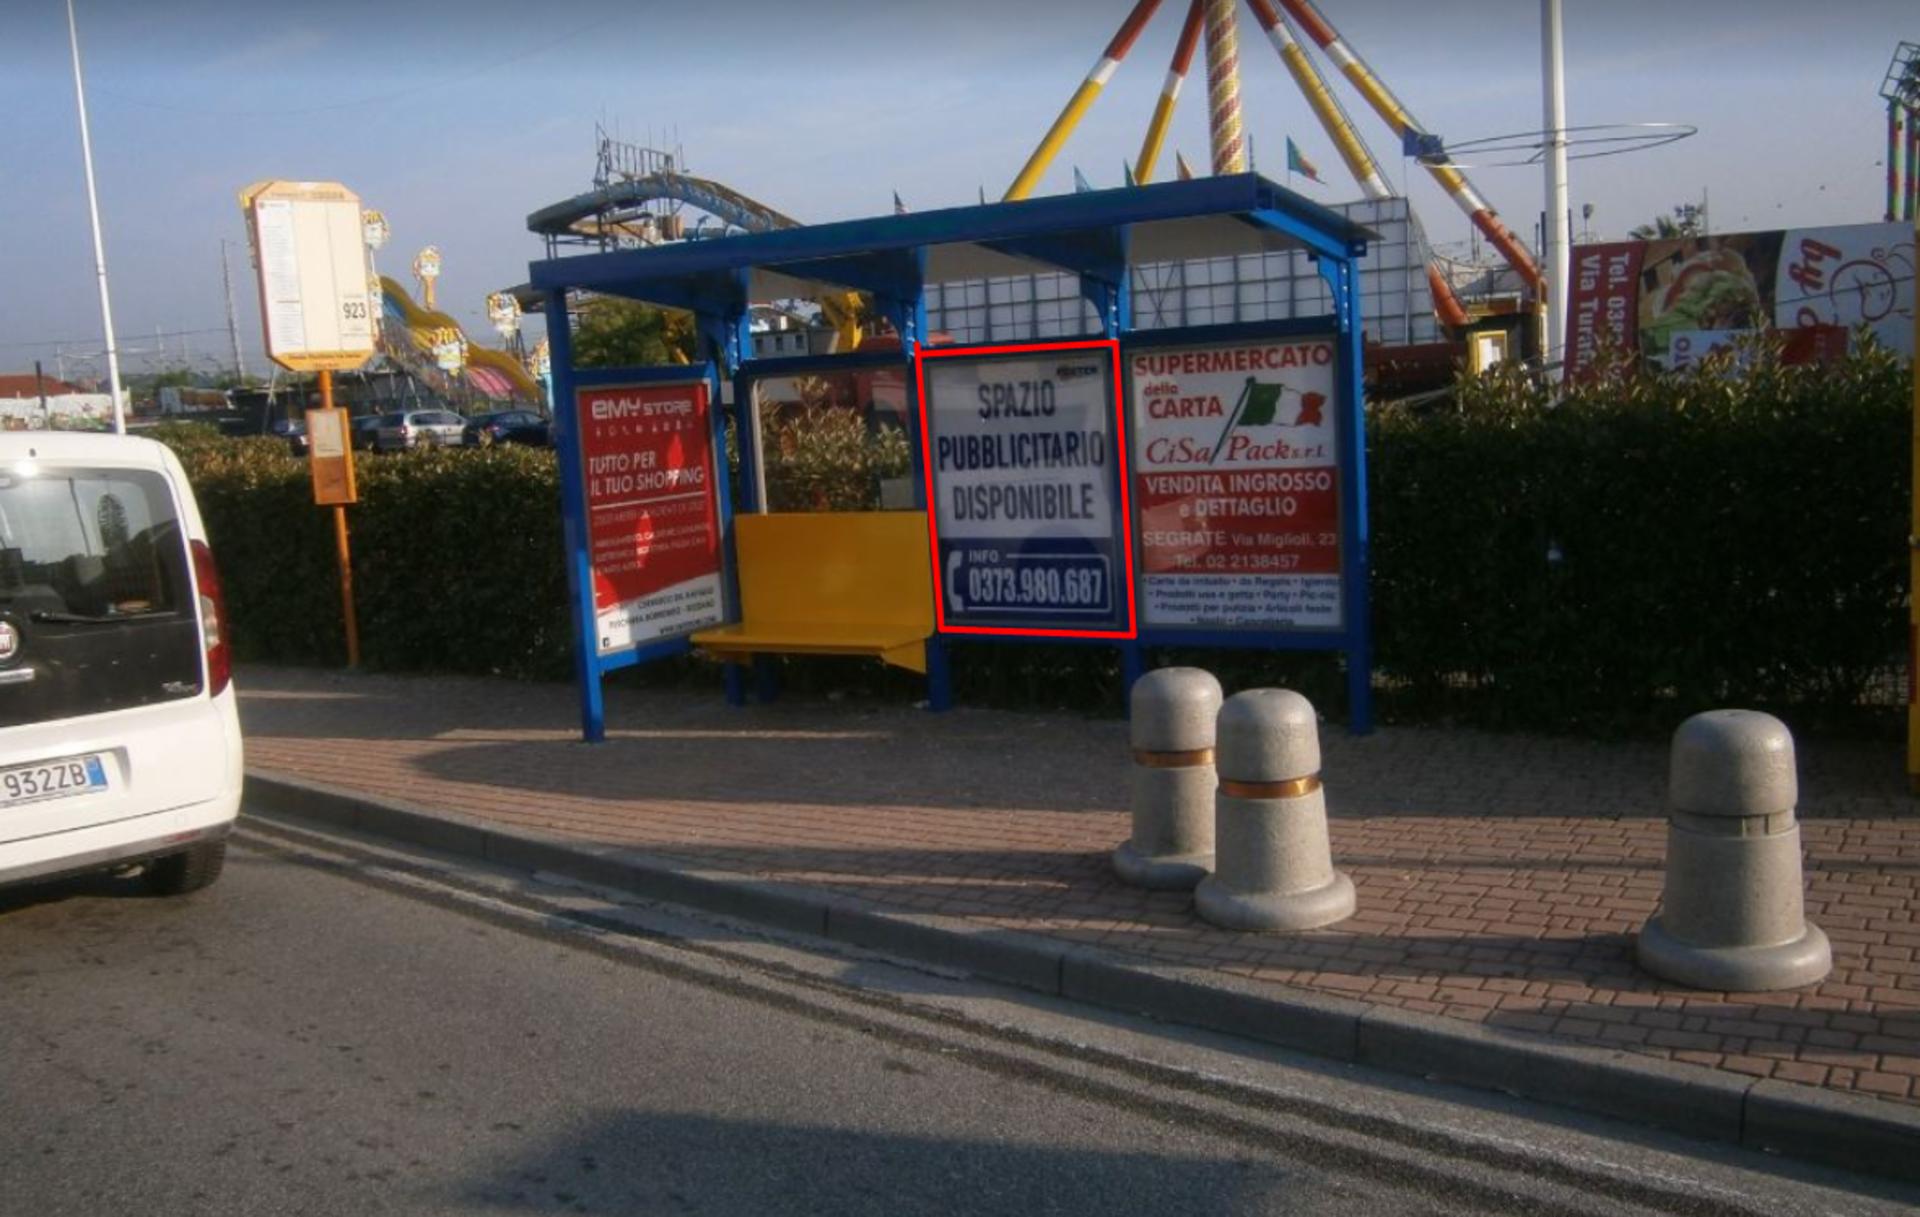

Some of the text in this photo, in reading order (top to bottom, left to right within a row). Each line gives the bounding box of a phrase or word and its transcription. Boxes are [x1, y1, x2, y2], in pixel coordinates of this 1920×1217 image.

[1581, 254, 1601, 291] Via
[1609, 252, 1630, 291] Tel.
[342, 302, 366, 319] 923
[1135, 344, 1332, 376] SUPERMERCATO
[977, 379, 1056, 420] SPAZIO
[1143, 382, 1178, 396] della
[643, 400, 693, 416] STORE
[1149, 395, 1224, 419] CARTA
[589, 450, 657, 475] TUTTO PER
[937, 431, 1105, 472] PUBBLICITARIO
[1146, 435, 1211, 465] CiSa
[1225, 435, 1291, 462] Pack
[591, 466, 705, 496] IL TUO SHOPPING
[1145, 471, 1331, 495] VENDITA INGROSSO
[953, 484, 1095, 520] DISPONIBILE
[1179, 497, 1297, 517] e DETTAGLIO
[1142, 530, 1226, 547] SEGRATE
[1231, 534, 1255, 547] Via
[1319, 532, 1336, 546] 23
[969, 549, 998, 562] INFO
[1174, 555, 1300, 568] Tel. 02 2138457
[968, 566, 1102, 603] 0373.980.687
[4, 762, 86, 798] 932ZB
